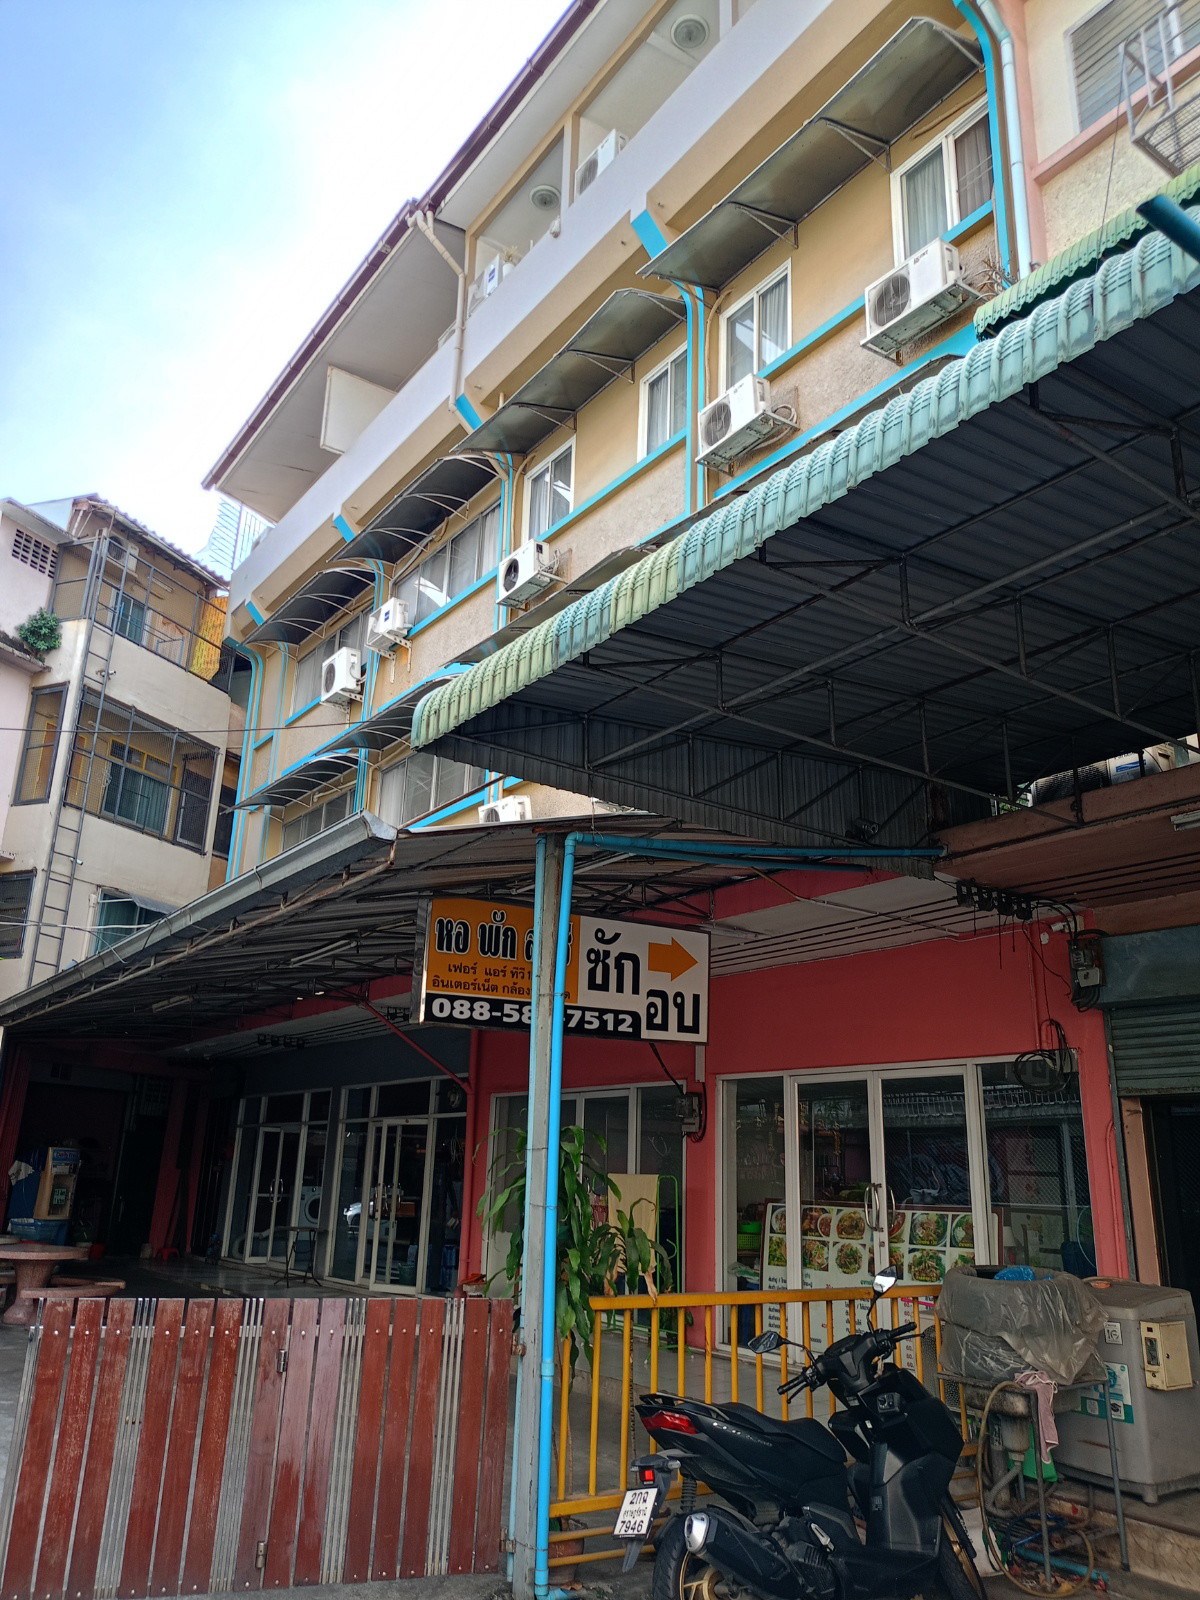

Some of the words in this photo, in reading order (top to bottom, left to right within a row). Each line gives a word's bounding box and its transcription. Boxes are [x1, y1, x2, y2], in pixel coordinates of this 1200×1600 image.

[435, 917, 471, 955] หอ
[447, 961, 478, 975] เฟอร์
[484, 965, 508, 978] แอร์
[432, 974, 499, 993] อินเตอร์เน็ต
[645, 988, 701, 1035] อบ
[619, 1520, 644, 1533] 7946
